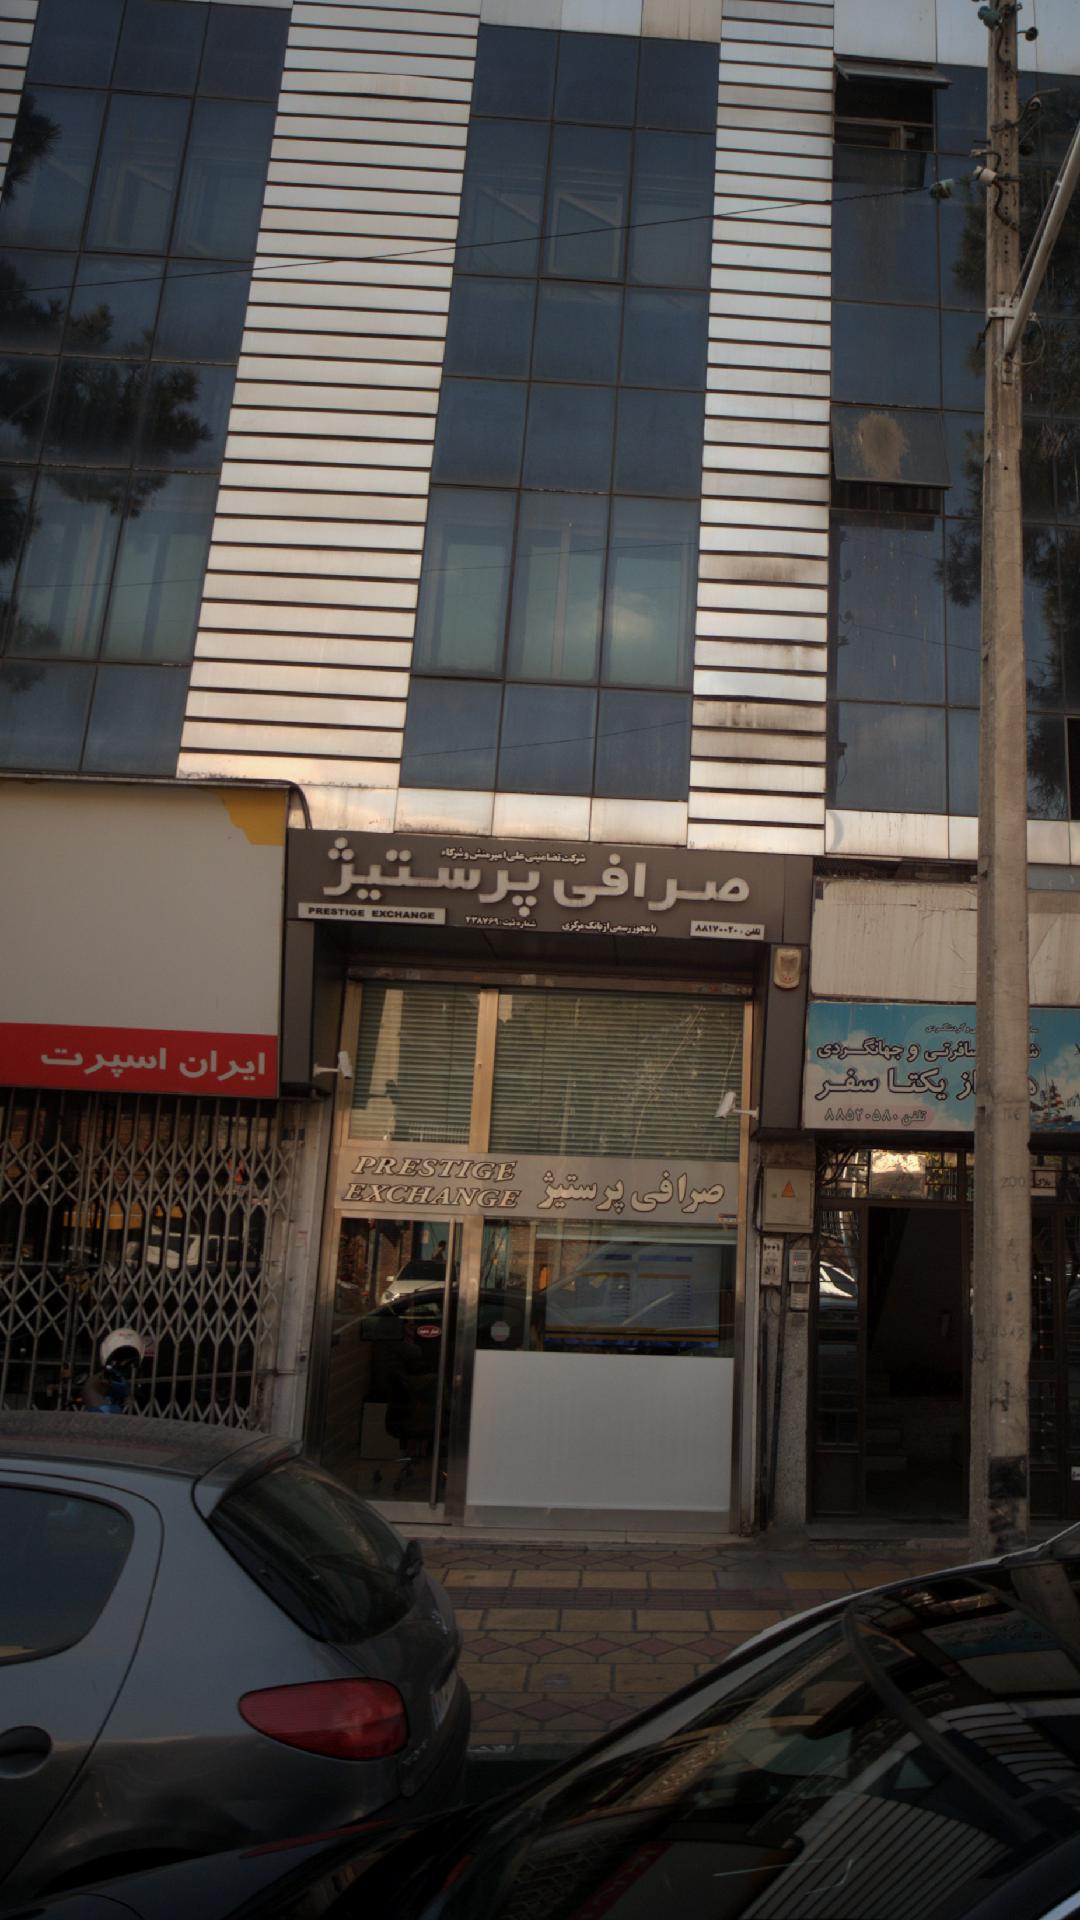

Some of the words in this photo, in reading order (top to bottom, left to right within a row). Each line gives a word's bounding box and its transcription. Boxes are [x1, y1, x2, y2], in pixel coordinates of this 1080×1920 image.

[323, 836, 541, 917] پرستیژ
[552, 853, 750, 912] صرافی
[307, 906, 365, 917] PRESTIGE
[371, 910, 436, 920] EXCHANGE
[40, 1046, 167, 1078] اسپرت
[178, 1049, 266, 1082] ایران
[816, 1037, 904, 1062] جهانگردی
[907, 1043, 920, 1062] و
[814, 1067, 880, 1100] سفر
[887, 1065, 948, 1101] یکتا
[901, 1108, 928, 1127] تلفن
[351, 1155, 518, 1182] PRESTIGE
[341, 1182, 522, 1209] EXCHANGE
[536, 1170, 626, 1215] پرستیژ
[631, 1170, 726, 1214] صرافی
